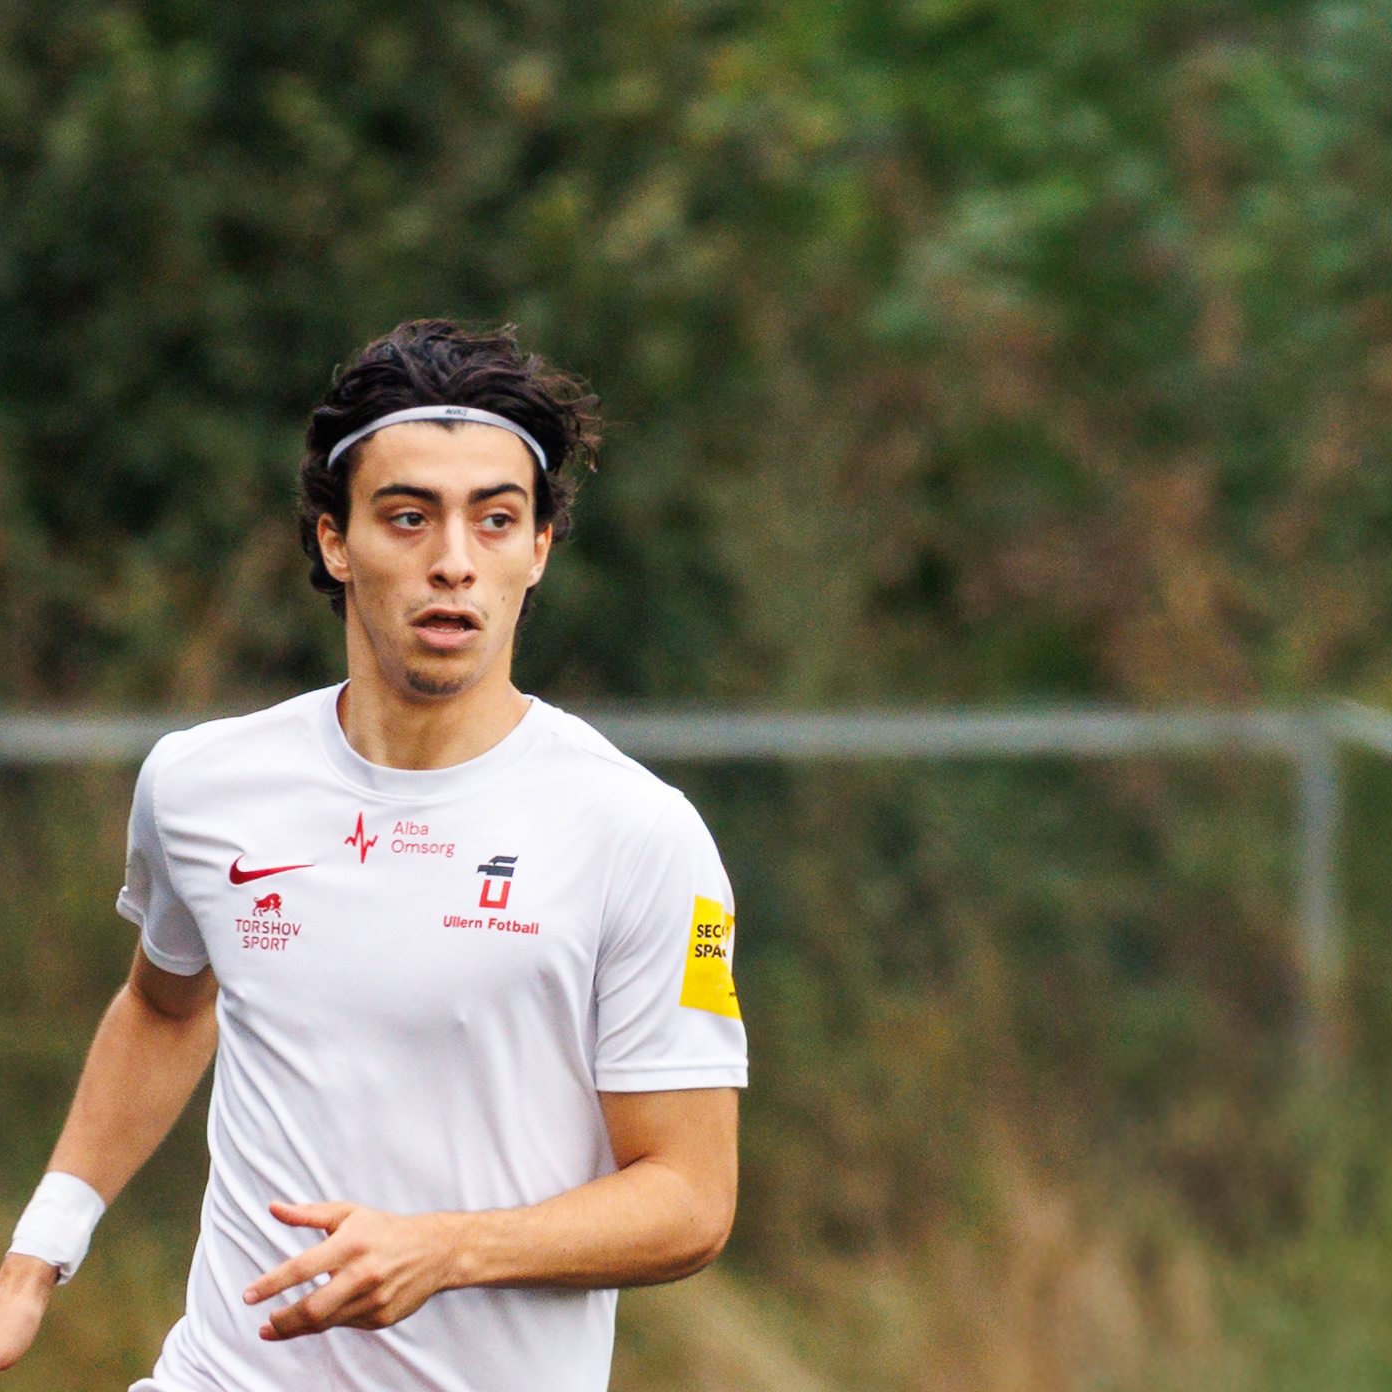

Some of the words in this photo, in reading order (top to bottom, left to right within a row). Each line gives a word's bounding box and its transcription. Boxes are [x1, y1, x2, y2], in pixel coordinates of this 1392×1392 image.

[393, 821, 429, 836] Alba
[391, 839, 456, 858] Omsorg
[235, 919, 302, 936] TORSHOV
[443, 915, 483, 929] Ullern
[488, 918, 540, 935] Fotball
[242, 935, 289, 951] SPORT
